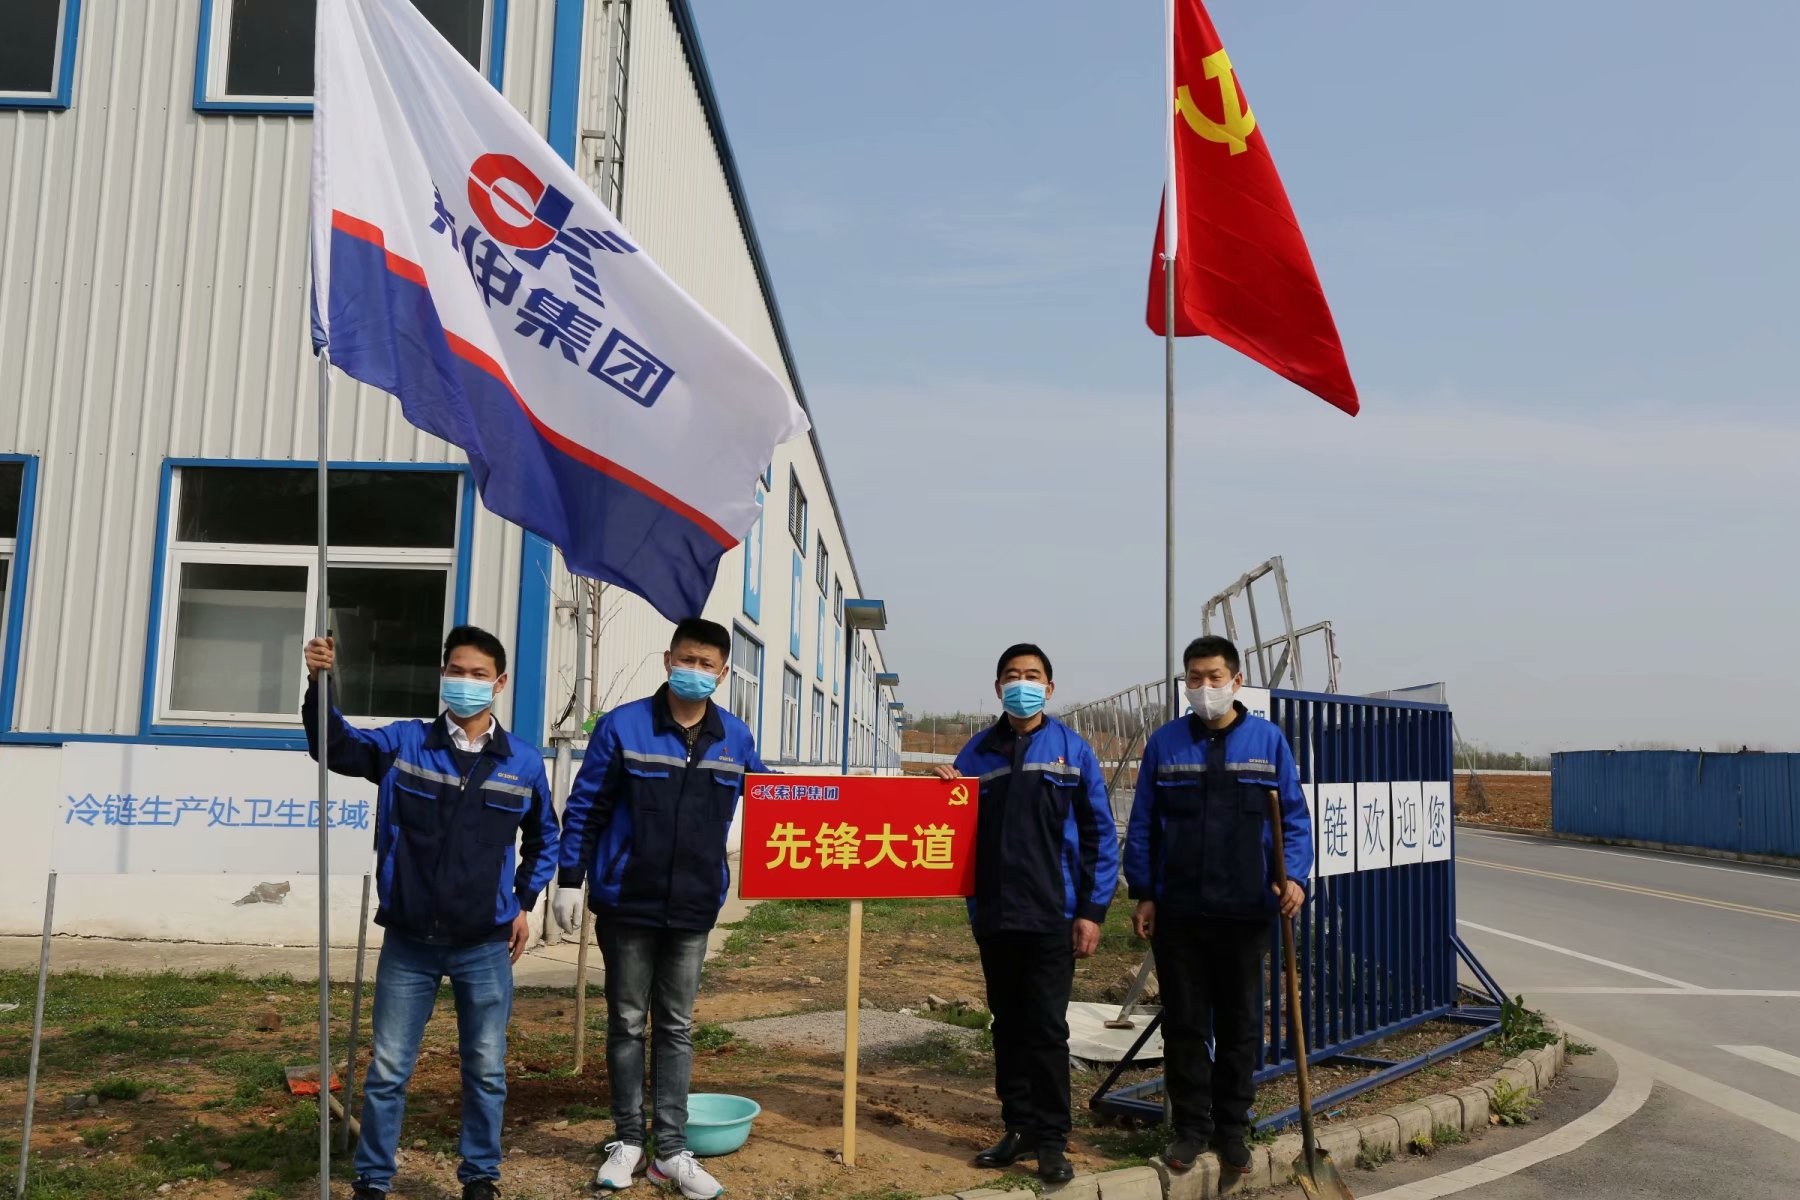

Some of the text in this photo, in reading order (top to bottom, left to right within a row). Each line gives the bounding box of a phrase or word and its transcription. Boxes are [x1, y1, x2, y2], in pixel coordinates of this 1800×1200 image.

[65, 793, 370, 830] 冷链生产处卫生区域
[1323, 795, 1446, 857] 链欢迎您
[765, 821, 956, 870] 先锋大道
